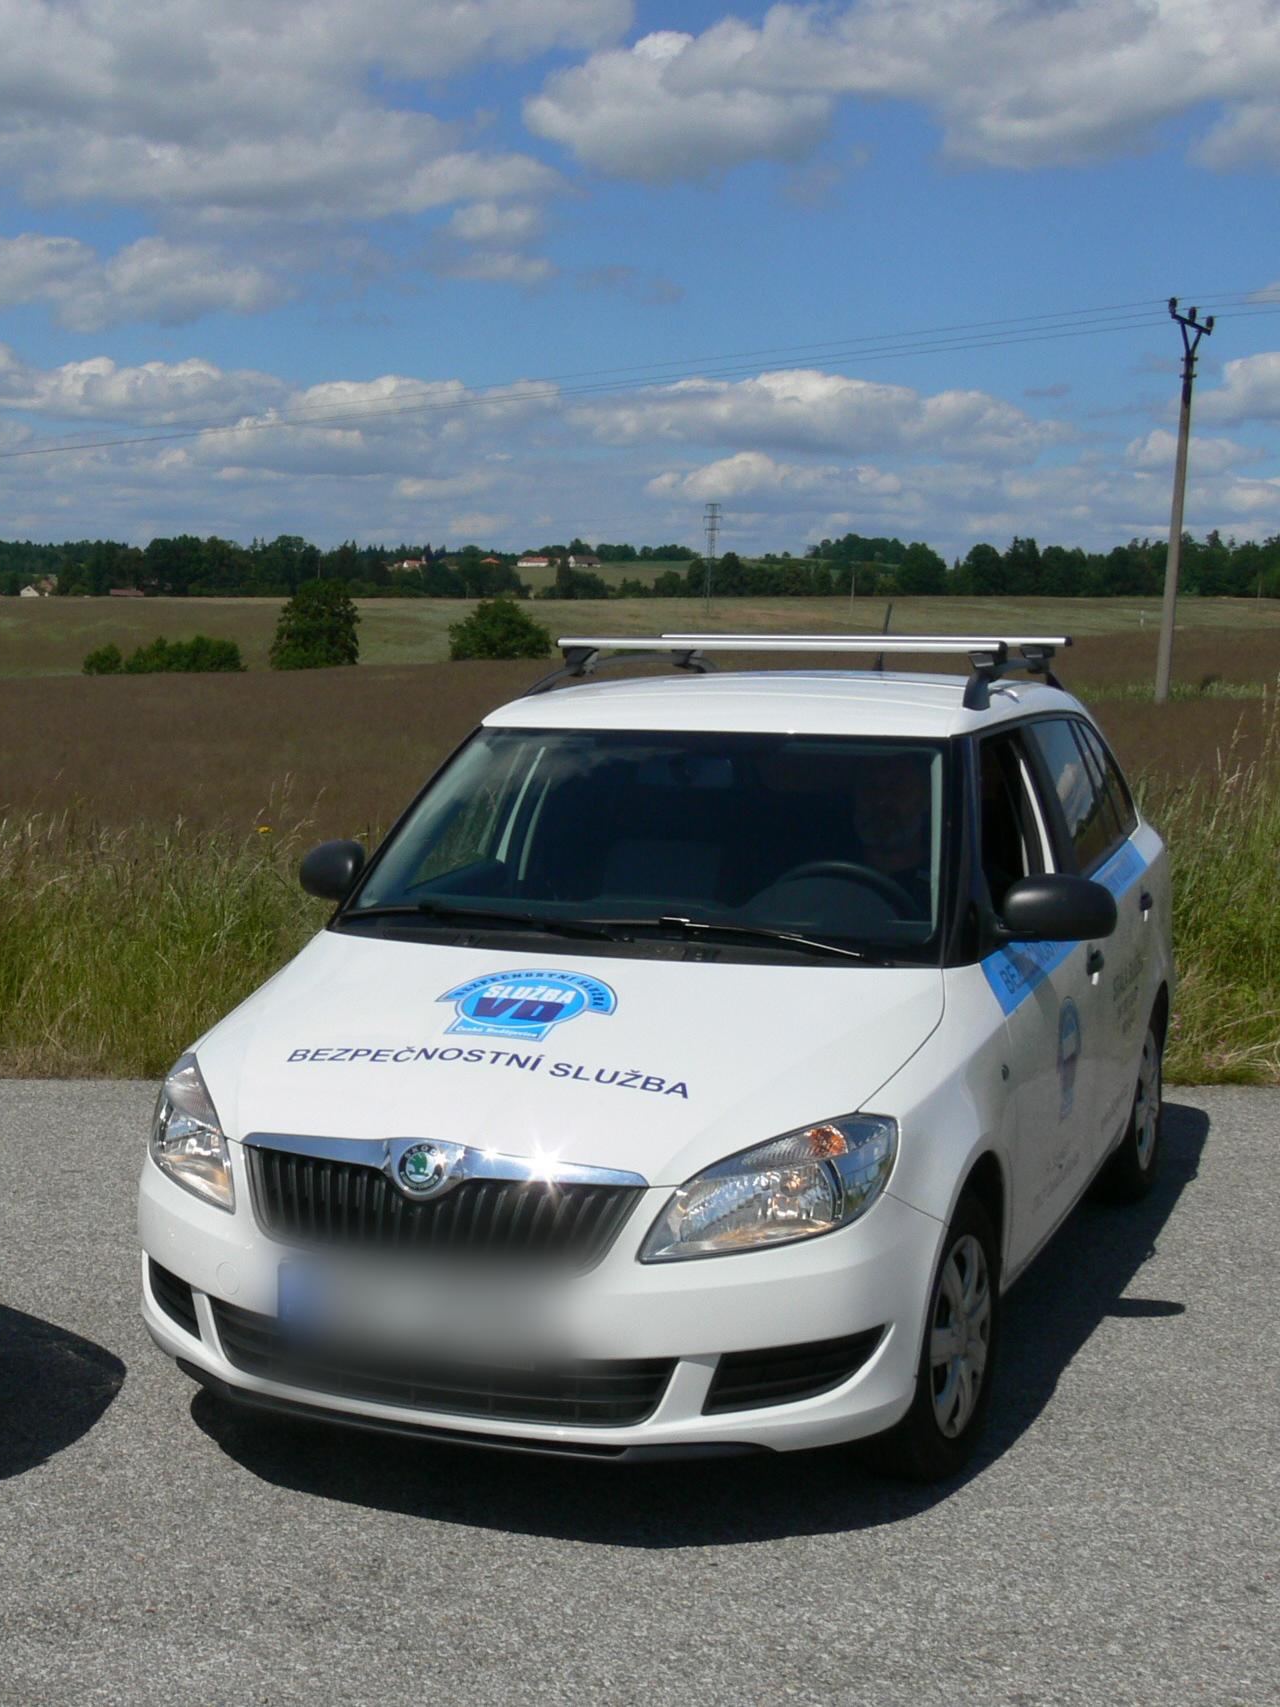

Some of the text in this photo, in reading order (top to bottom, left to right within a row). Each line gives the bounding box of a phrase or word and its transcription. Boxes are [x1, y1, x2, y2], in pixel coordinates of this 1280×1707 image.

[482, 983, 577, 1005] SLUŽBA
[471, 996, 565, 1023] VD
[287, 1046, 690, 1099] BEZPEČNOSTNÍ SLUŽBA
